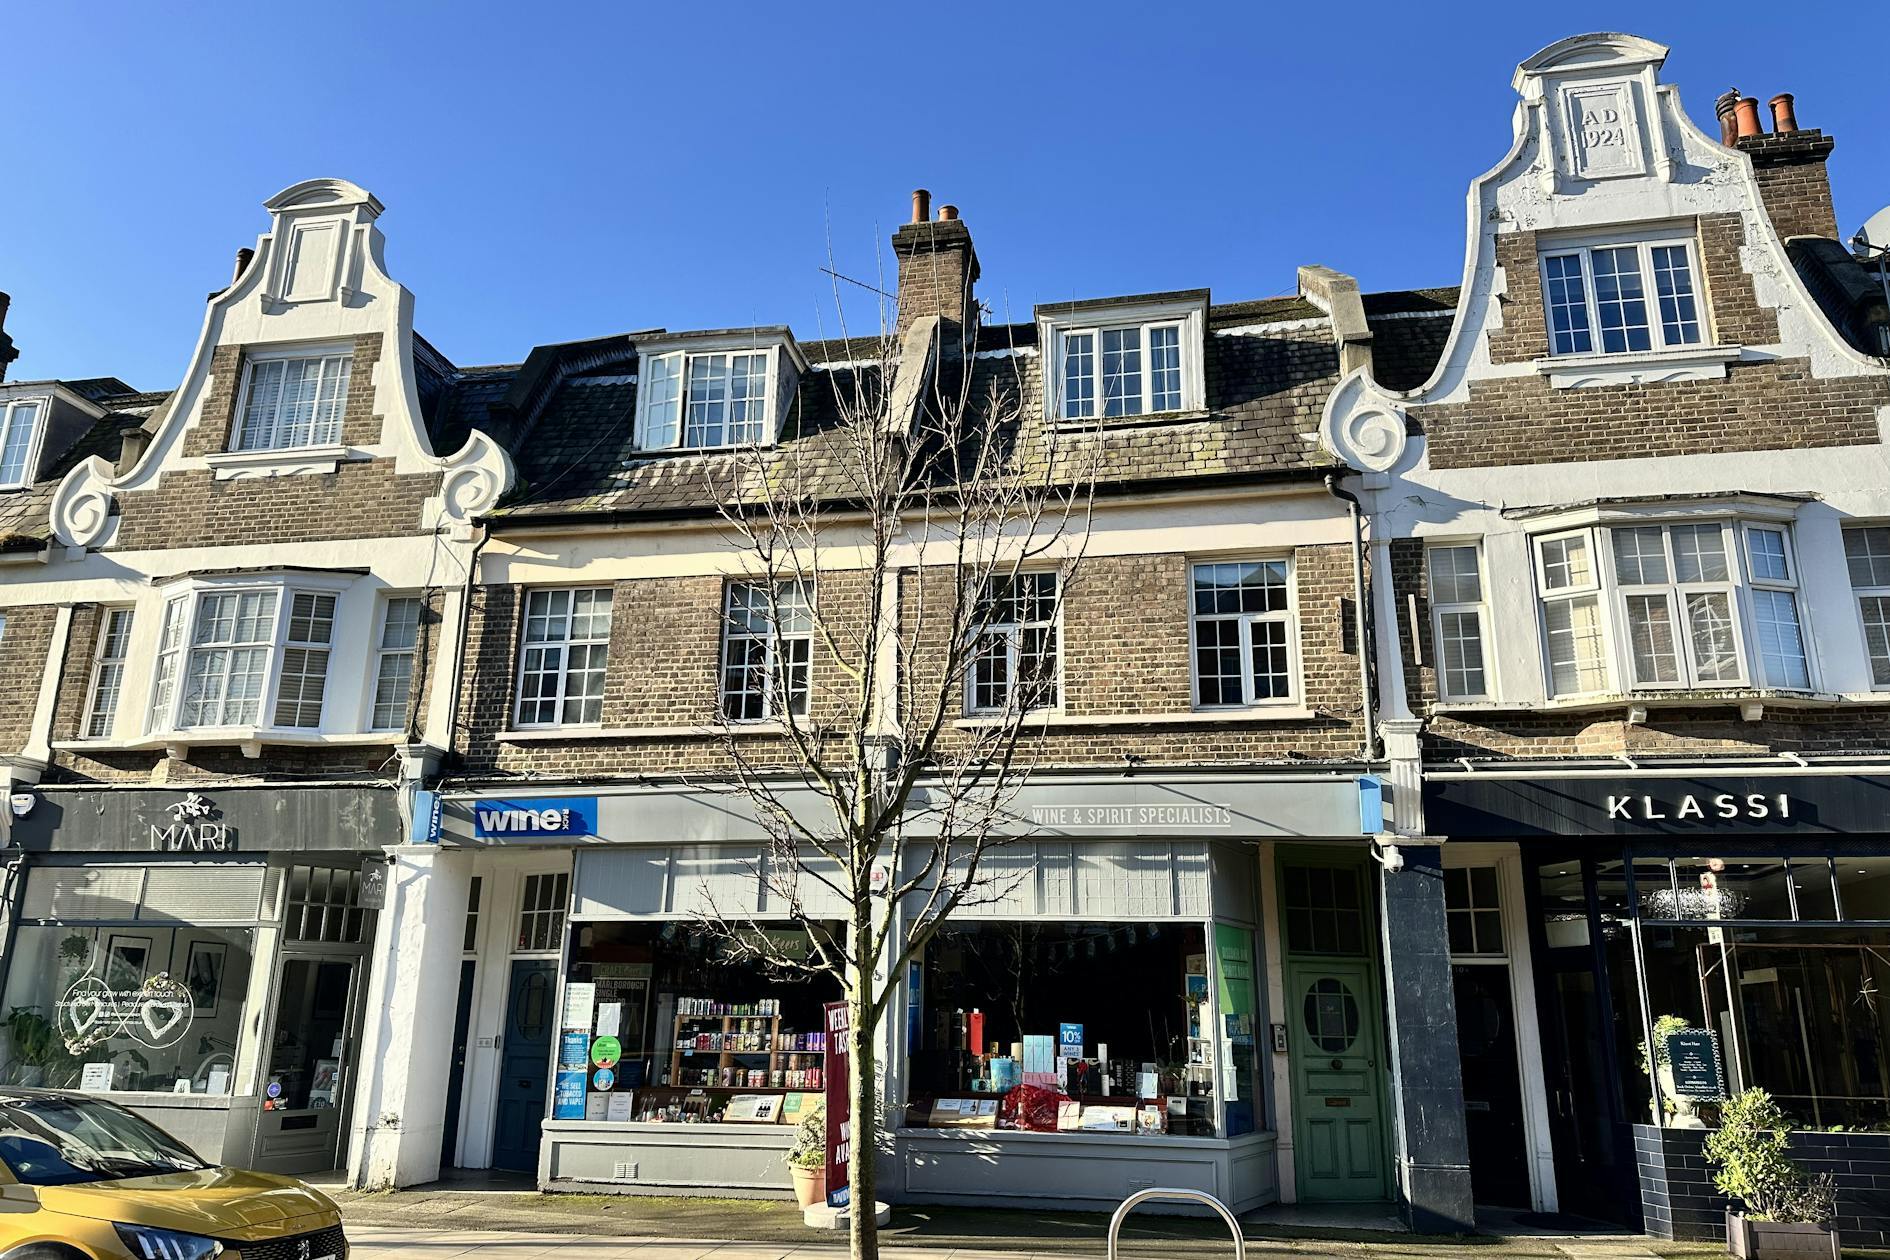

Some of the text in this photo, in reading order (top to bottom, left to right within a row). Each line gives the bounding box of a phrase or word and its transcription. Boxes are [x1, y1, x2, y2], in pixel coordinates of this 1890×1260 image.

[1582, 108, 1618, 126] A D
[1581, 127, 1625, 148] 1924
[1032, 807, 1231, 825] WINE & SPIRIT SPECIALISTS
[1607, 793, 1790, 820] KLASSI
[430, 800, 440, 838] wine
[479, 808, 570, 832] wine RACK
[150, 823, 226, 850] MARI
[361, 881, 386, 896] MARI
[595, 989, 618, 997] SINGLE
[1062, 1030, 1081, 1043] 10%
